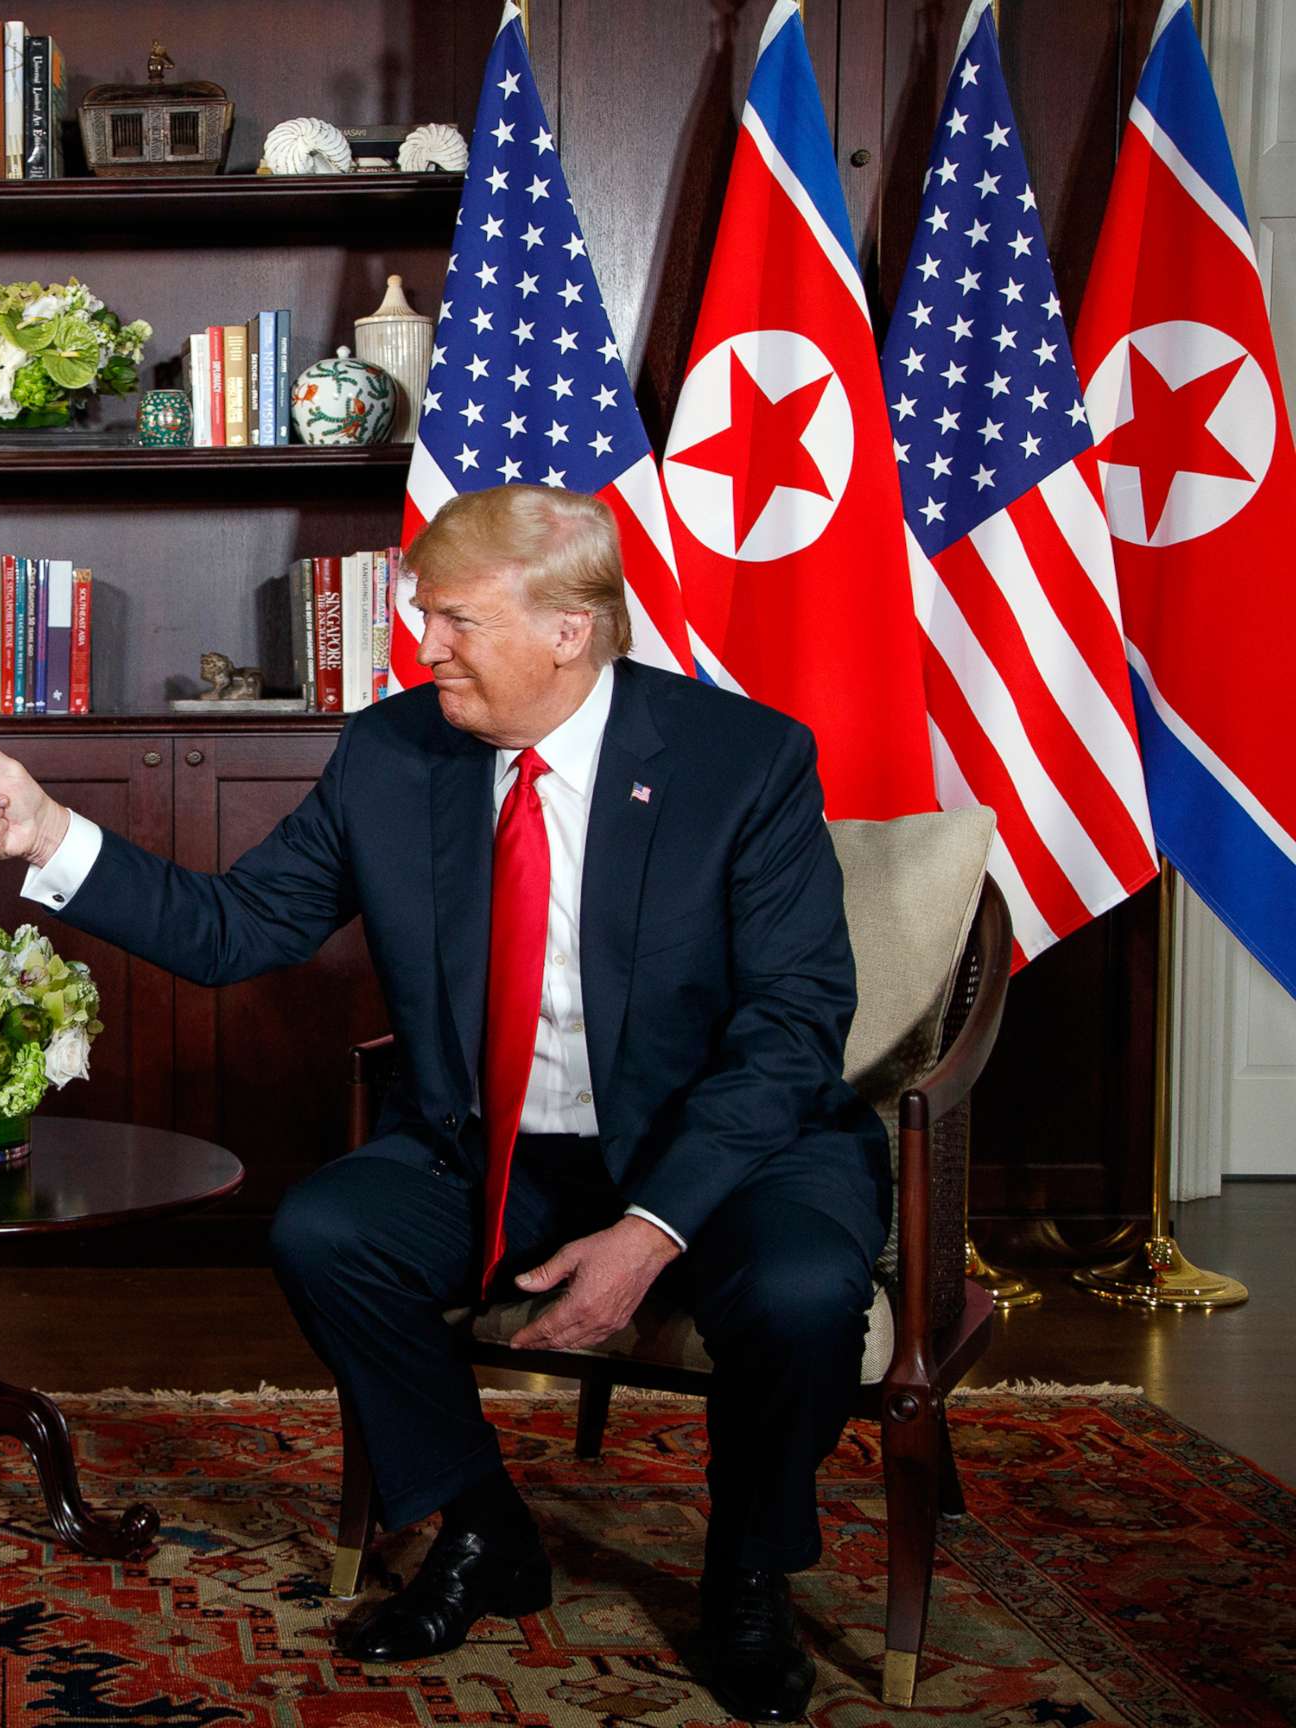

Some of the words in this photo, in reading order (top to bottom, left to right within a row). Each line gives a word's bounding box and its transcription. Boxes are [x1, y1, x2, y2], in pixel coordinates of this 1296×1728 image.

[264, 352, 274, 391] NIGHT
[263, 398, 274, 445] VISION
[361, 561, 369, 602] VANISHING
[378, 560, 386, 585] YAYOI
[377, 587, 385, 624] KUSAMA
[325, 592, 342, 671] SINGAPORE
